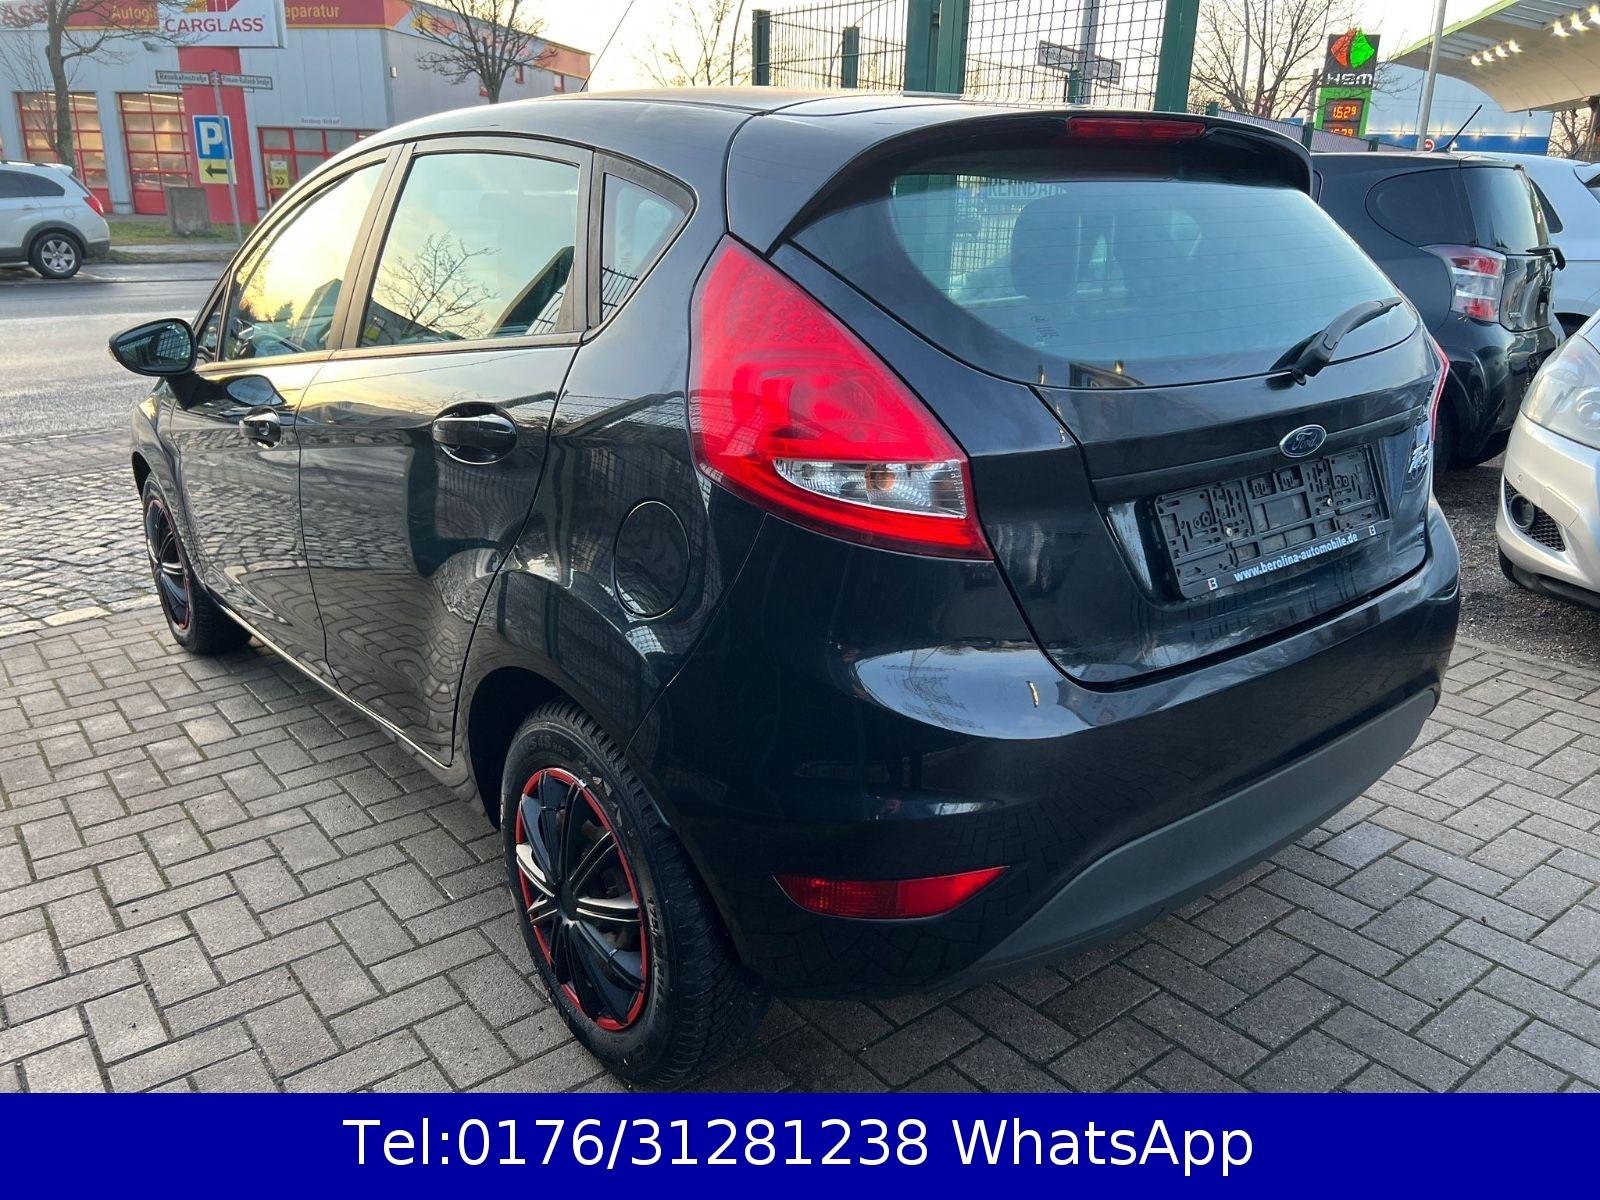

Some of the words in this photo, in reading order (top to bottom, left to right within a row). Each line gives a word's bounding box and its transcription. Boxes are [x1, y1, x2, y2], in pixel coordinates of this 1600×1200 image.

[165, 18, 263, 32] CARGLASS
[201, 122, 223, 154] P
[1234, 532, 1358, 583] www.berolina-automobile.de
